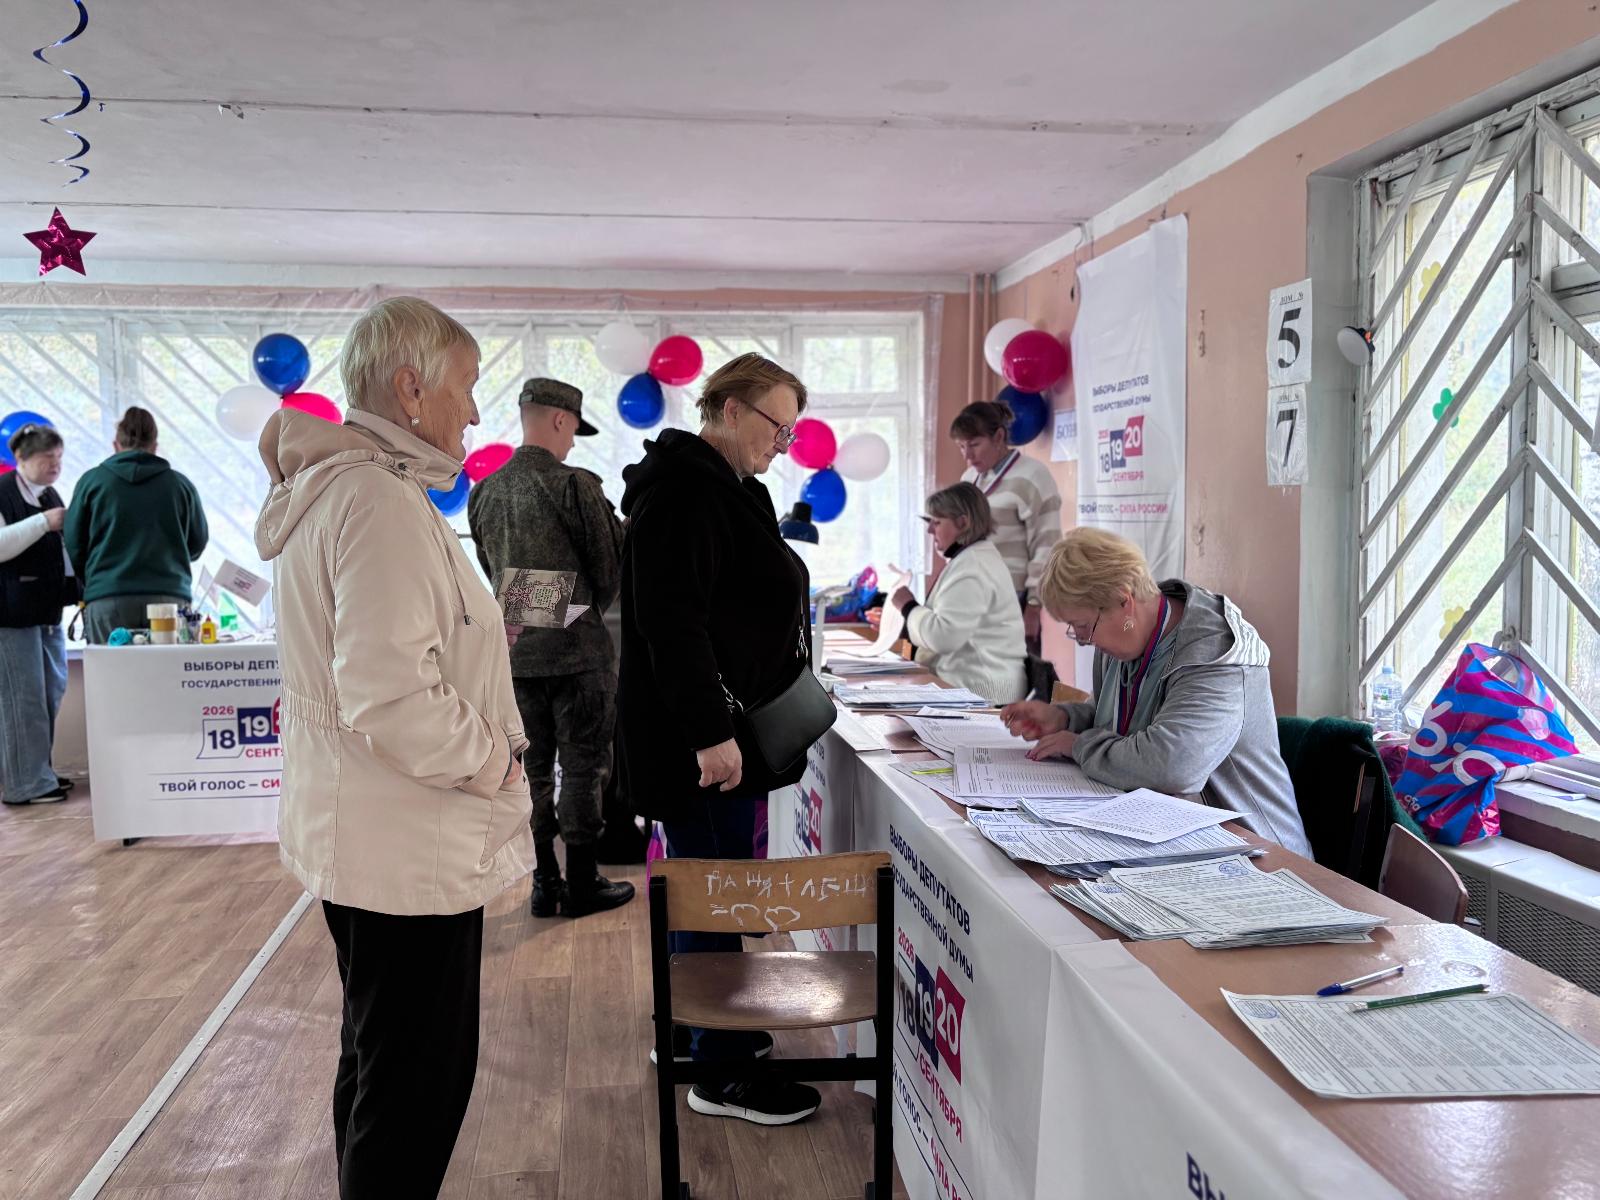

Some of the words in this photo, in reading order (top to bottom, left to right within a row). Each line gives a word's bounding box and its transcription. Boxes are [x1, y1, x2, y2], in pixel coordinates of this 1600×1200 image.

[1278, 307, 1301, 369] 5
[1100, 453, 1110, 473] 18
[1111, 439, 1123, 461] 19
[1125, 426, 1141, 449] 20
[1276, 408, 1298, 467] 7
[184, 660, 244, 672] ВЫБОРЫ
[202, 706, 235, 716] 2026
[208, 729, 236, 750] 18
[241, 715, 270, 738] 19
[160, 780, 197, 792] ТВОЙ
[200, 780, 246, 791] ГОЛОС
[802, 804, 810, 837] 19
[810, 800, 820, 838] 20
[890, 824, 918, 875] ВЫБОРЫ
[919, 858, 971, 936] ДЕПУТАТОВ
[891, 863, 948, 951] ОСУДАРСТВЕННОЙ
[949, 936, 974, 983] ДУМЫ
[898, 926, 915, 963] 2026
[901, 981, 916, 1037] 18
[917, 982, 934, 1040] 19
[936, 987, 959, 1056] 20
[899, 1078, 921, 1134] ГОЛОС
[920, 1052, 962, 1143] СЕНТЯБРЯ
